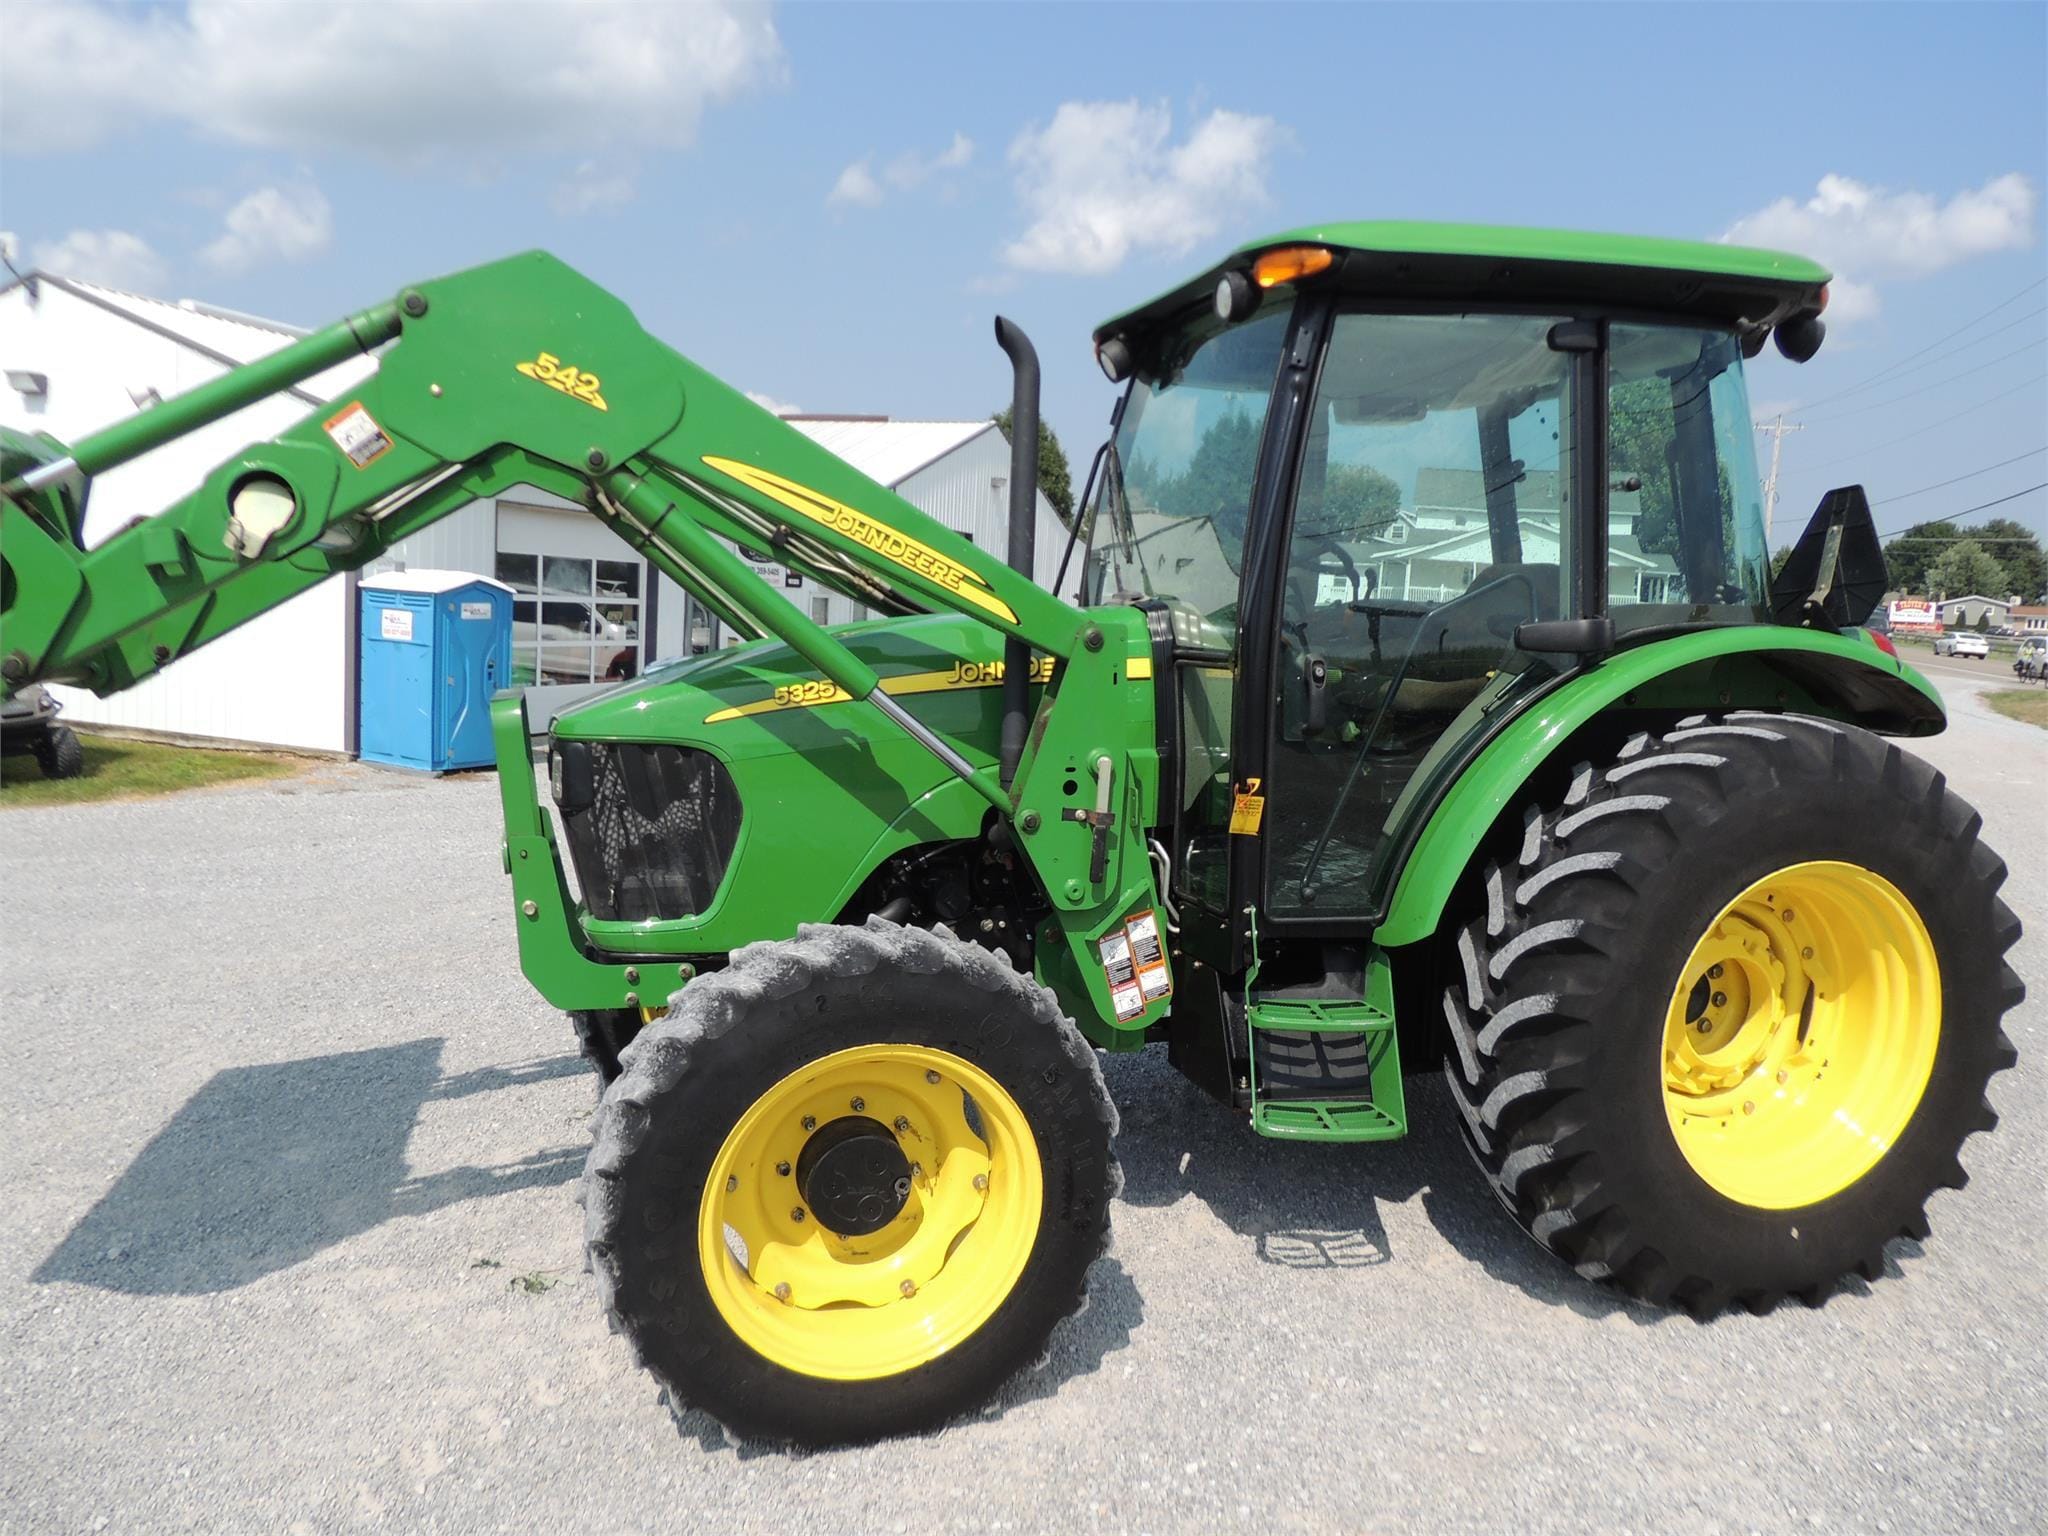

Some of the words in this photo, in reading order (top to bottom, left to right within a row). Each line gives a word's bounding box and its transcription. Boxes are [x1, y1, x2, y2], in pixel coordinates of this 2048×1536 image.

[532, 351, 601, 403] 542
[821, 507, 888, 550] JOHN
[884, 535, 966, 590] DEERE
[774, 680, 837, 706] 5325
